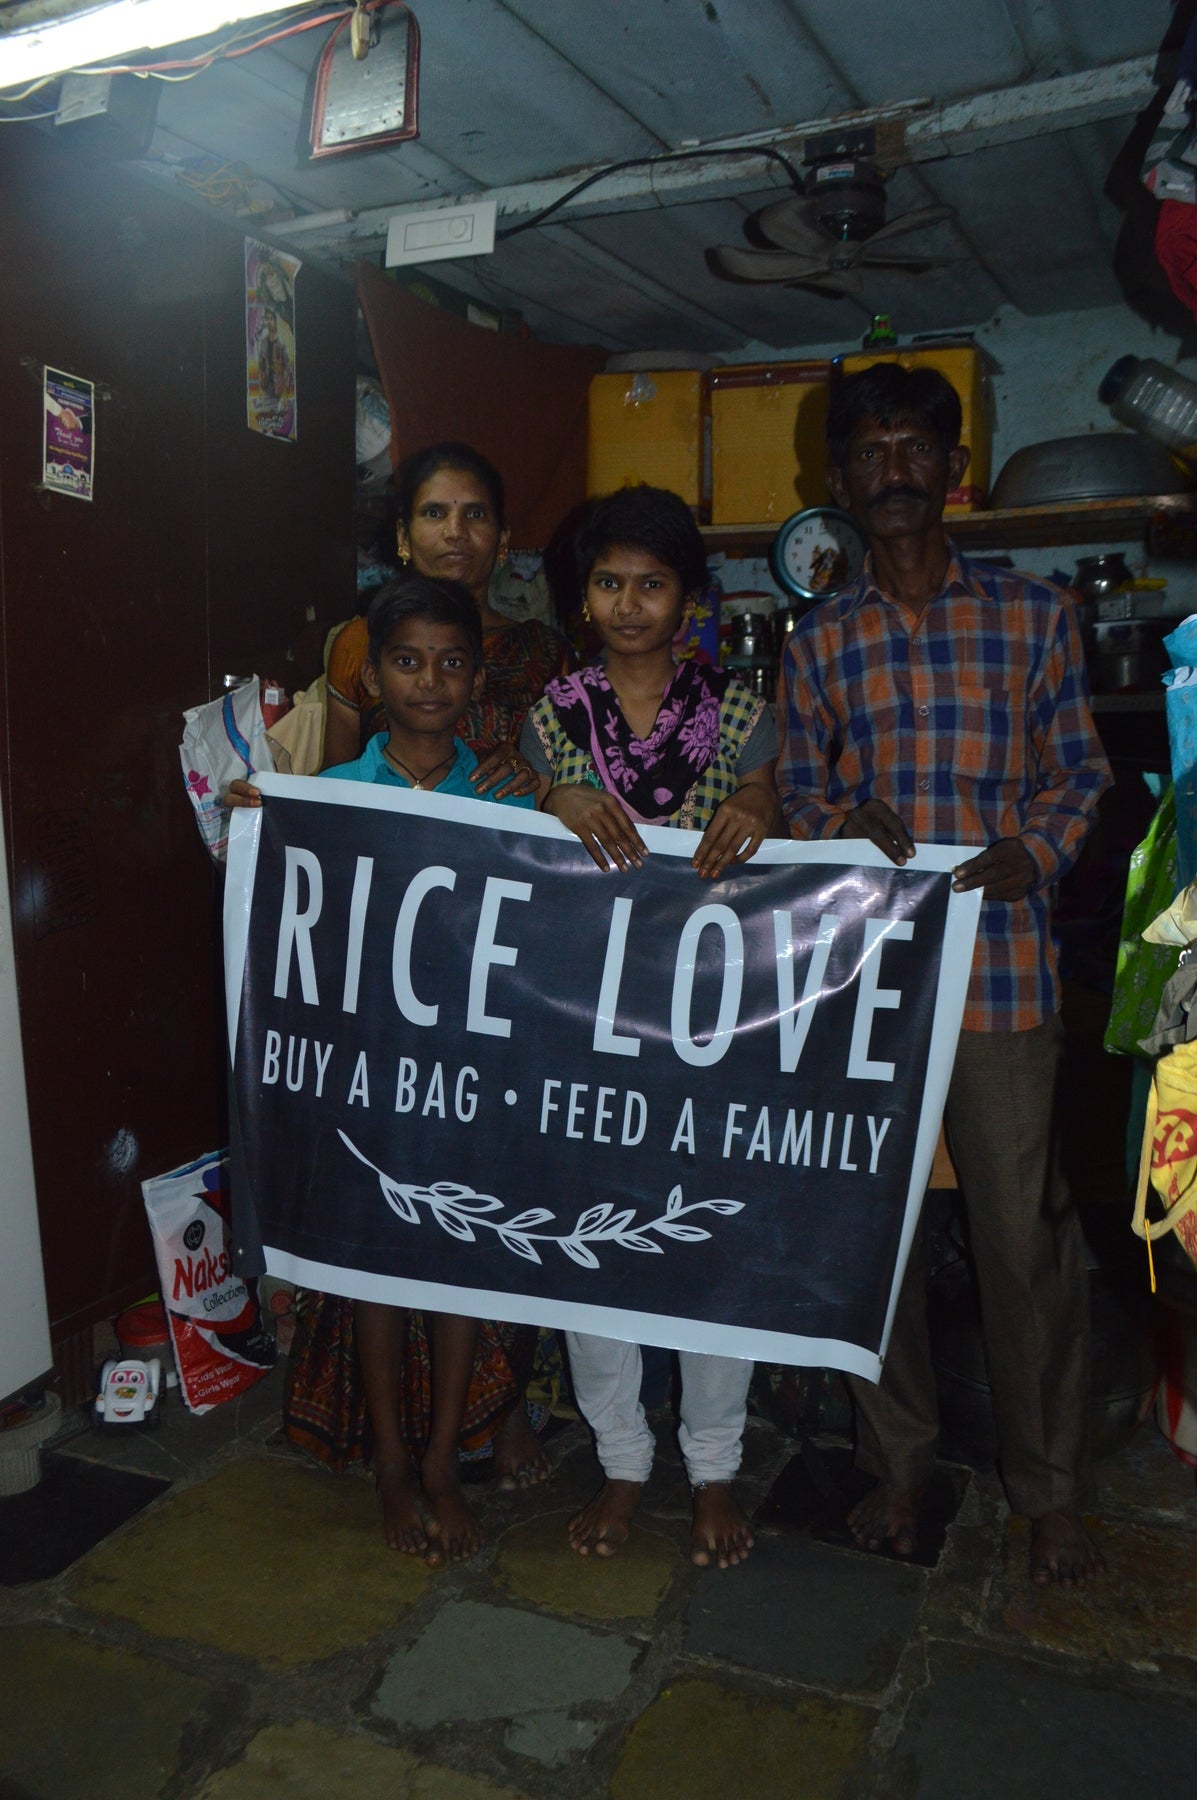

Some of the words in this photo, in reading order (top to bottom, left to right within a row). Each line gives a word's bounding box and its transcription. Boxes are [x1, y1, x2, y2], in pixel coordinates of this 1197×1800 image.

[274, 846, 533, 1038] RICE
[593, 897, 915, 1082] LOVE
[262, 1030, 333, 1098] BUY
[348, 1051, 370, 1107] A
[395, 1057, 479, 1123] BAG
[540, 1079, 648, 1146] FEED
[671, 1098, 695, 1154] A
[723, 1103, 892, 1173] FAMILY
[203, 1284, 246, 1312] Collections
